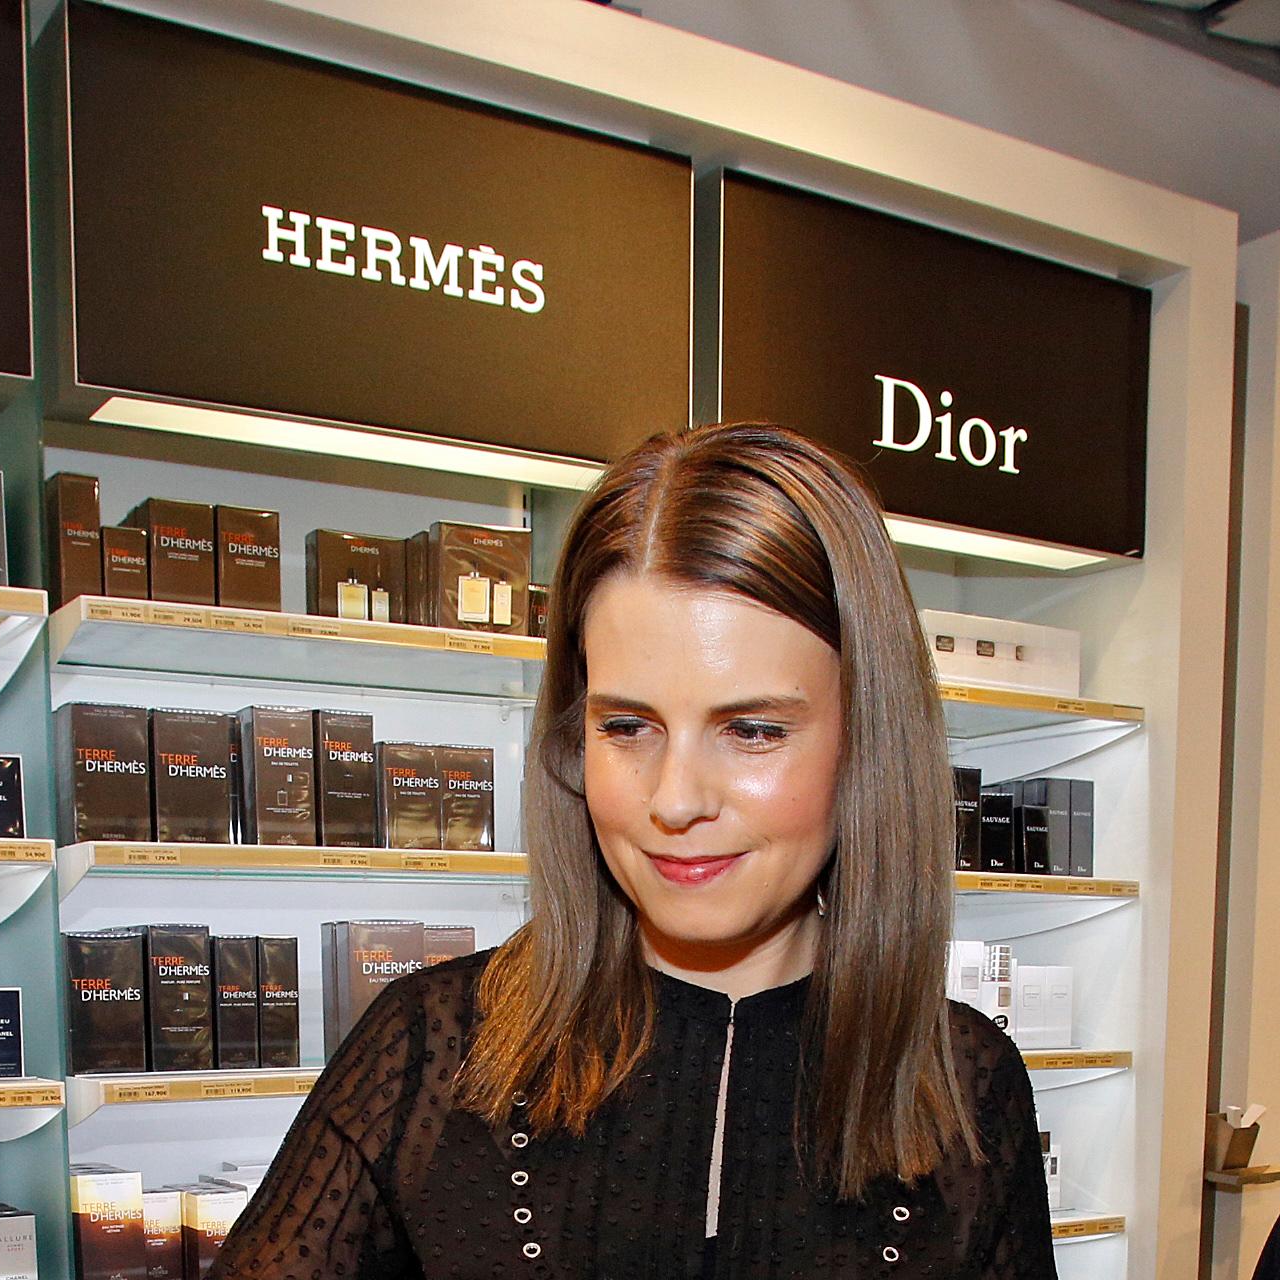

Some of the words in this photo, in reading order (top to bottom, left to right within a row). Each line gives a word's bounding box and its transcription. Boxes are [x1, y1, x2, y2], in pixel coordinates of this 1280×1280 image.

[262, 205, 545, 313] HERMÈS
[873, 374, 1027, 474] Dior
[161, 536, 213, 552] D'HERMÈS
[229, 543, 279, 558] D'HERMÈS
[256, 736, 289, 747] TERRE
[323, 741, 351, 751] TERRE
[77, 749, 116, 760] TERRE
[264, 746, 312, 759] D'HERMÈS
[330, 750, 373, 763] D'HERMÈS
[160, 753, 198, 765] TERRE
[86, 760, 145, 774] D'HERMÈS
[169, 765, 226, 779] D'HERMÈS
[386, 768, 416, 778] TERRE
[442, 770, 471, 780] TERRE
[393, 777, 439, 789] D'HERMÈS
[449, 779, 492, 791] D'HERMÈS
[151, 956, 184, 966] TERRE
[354, 950, 393, 963] TERRE
[159, 964, 210, 976] D'HERMÈS
[362, 961, 422, 975] D'HERMÈS
[73, 979, 111, 990] TERRE
[81, 987, 140, 1001] D'HERMÈS
[223, 991, 256, 999] D'HERMÈS
[266, 990, 298, 998] D'HERMÈS
[83, 1202, 116, 1213] TERRE
[90, 1208, 142, 1222] D'HERMÈS
